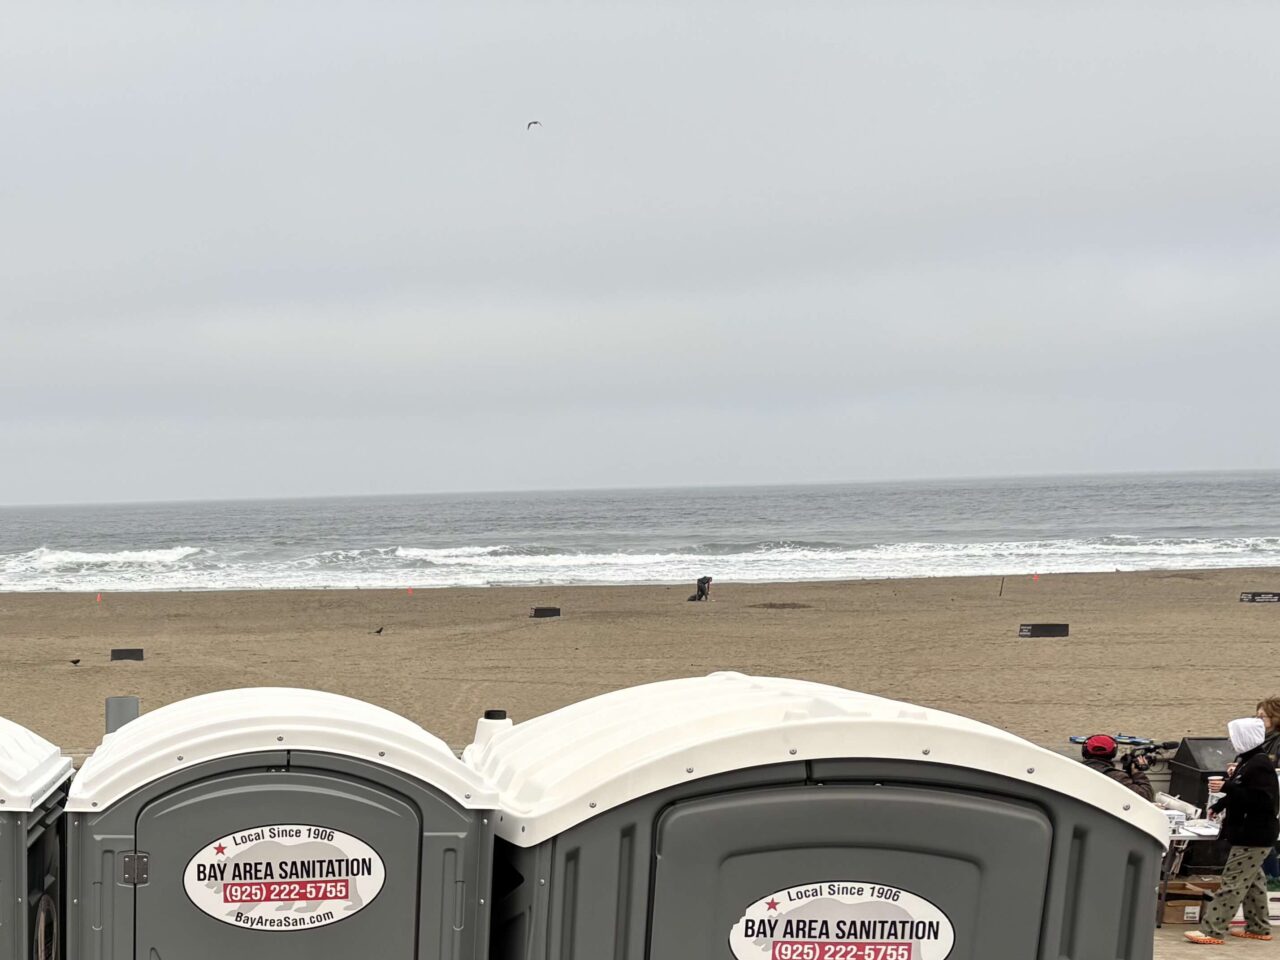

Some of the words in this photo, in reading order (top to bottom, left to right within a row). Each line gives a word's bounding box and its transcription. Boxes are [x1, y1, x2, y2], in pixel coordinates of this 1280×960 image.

[233, 829, 265, 846] Local
[269, 828, 302, 839] Since
[306, 827, 335, 842] 1906
[197, 863, 227, 881] BAY
[232, 862, 273, 881] AREA
[279, 858, 371, 879] SANITATION
[226, 884, 266, 901] (925)
[270, 882, 346, 899] 222-5755
[787, 885, 823, 902] Local
[828, 884, 864, 896] Since
[870, 886, 901, 902] 1906
[235, 911, 333, 927] BayAreaSan.com
[745, 919, 779, 938] BAY
[783, 919, 830, 939] AREA
[836, 920, 939, 940] SANITATION
[775, 943, 819, 960] (925)
[824, 944, 908, 960] 222-5755
